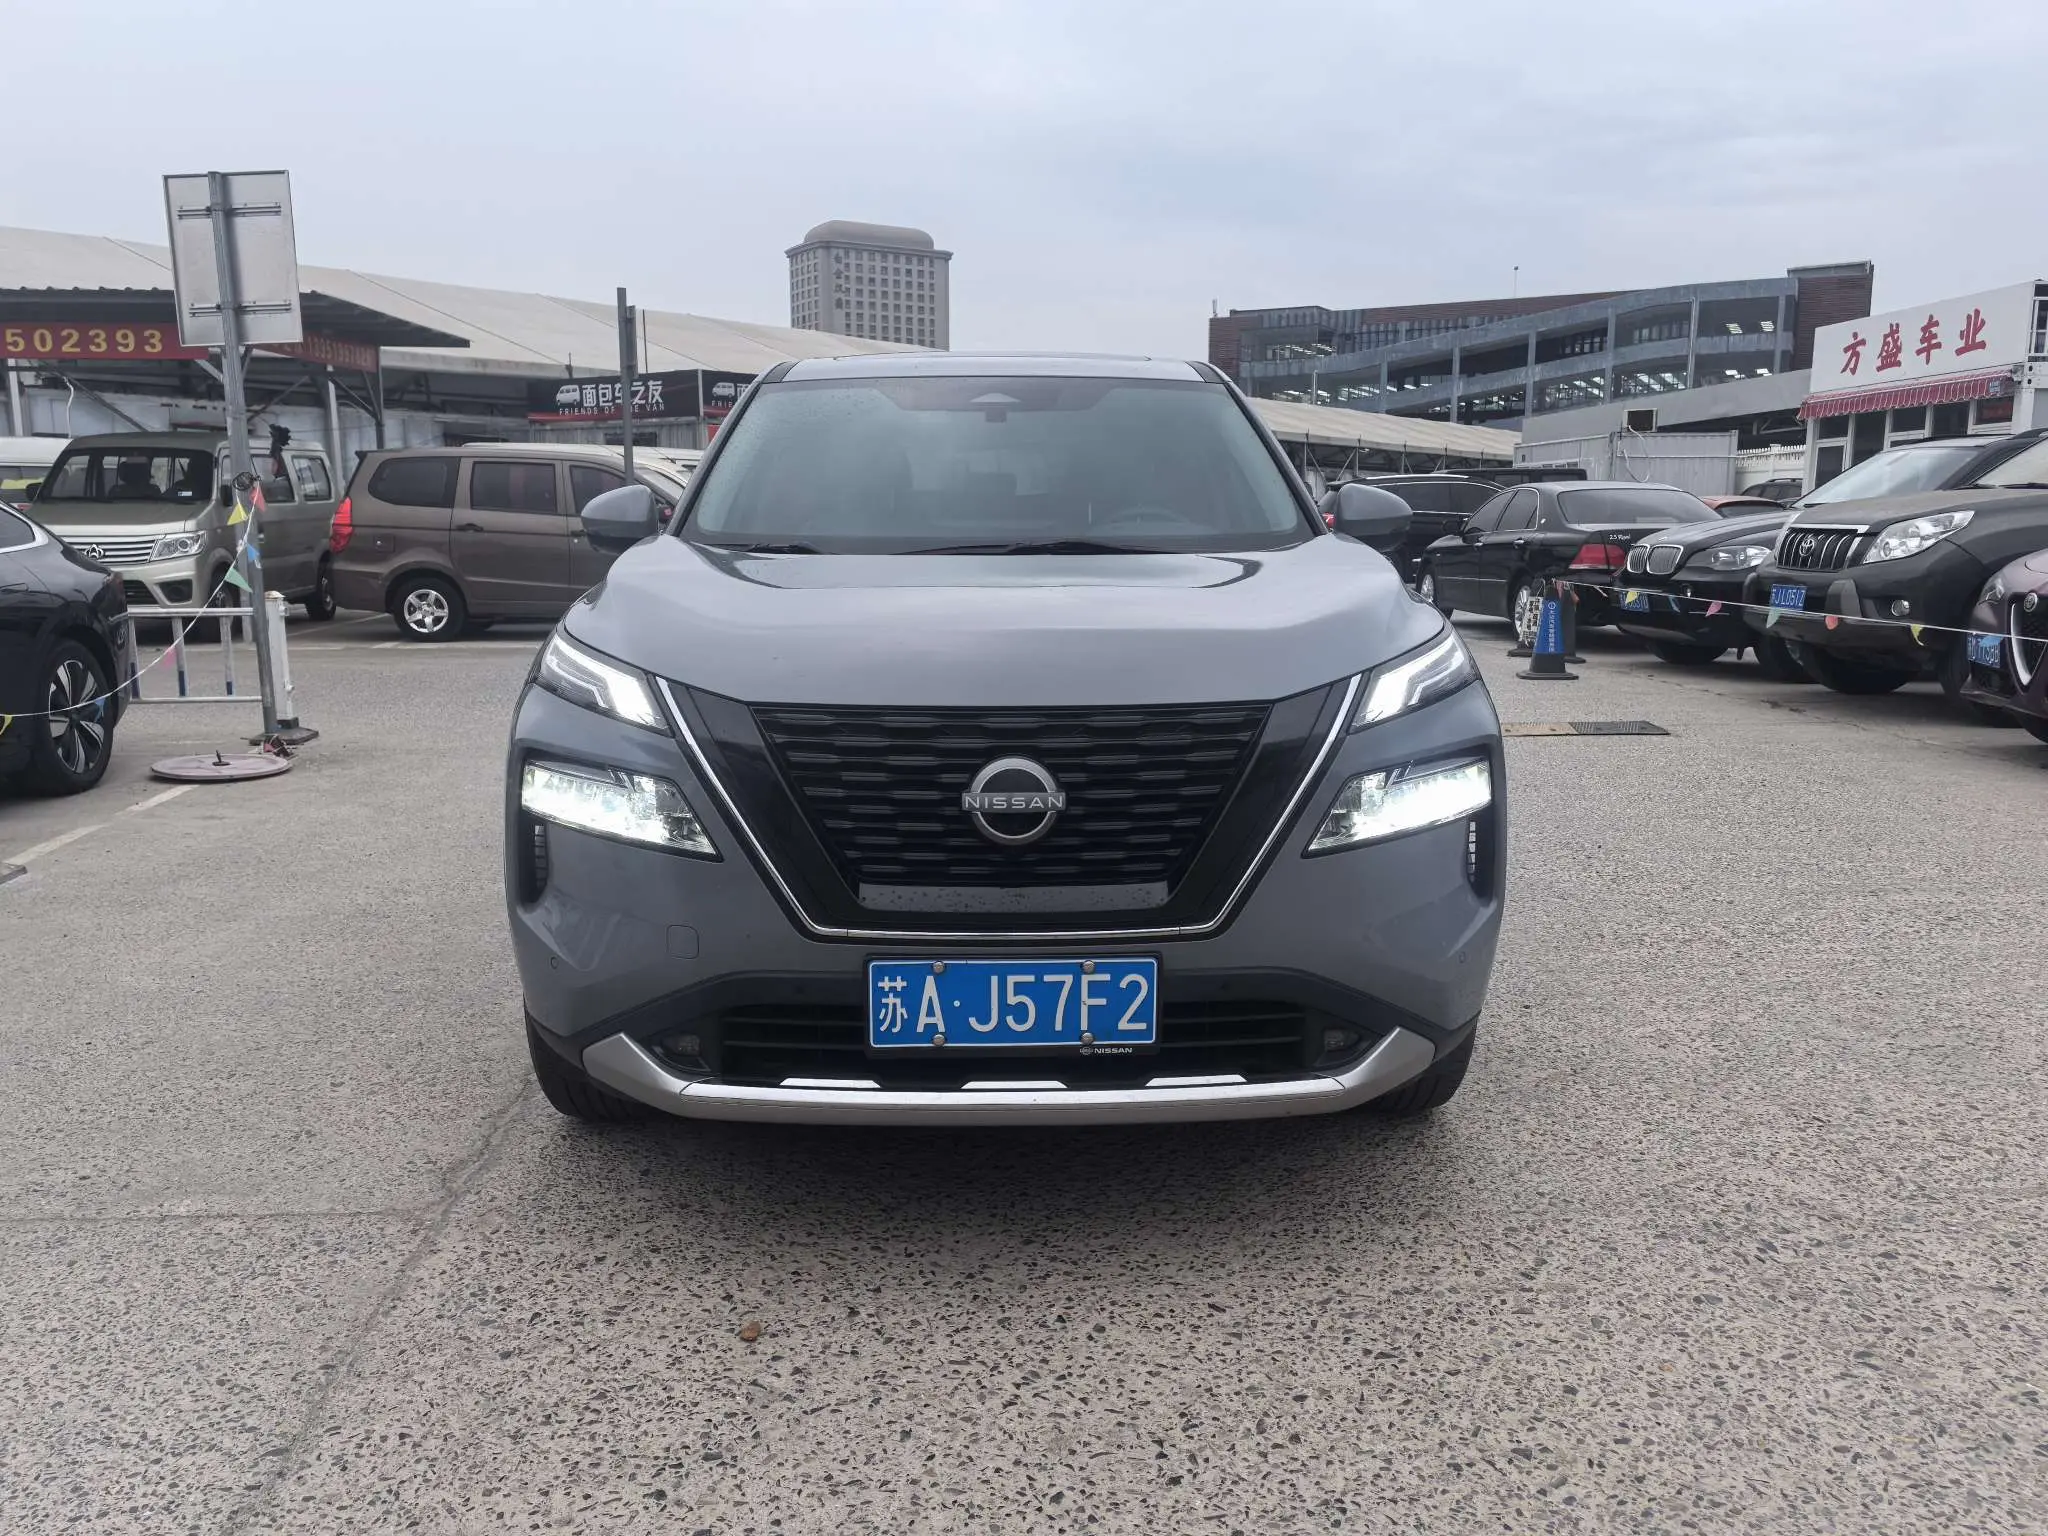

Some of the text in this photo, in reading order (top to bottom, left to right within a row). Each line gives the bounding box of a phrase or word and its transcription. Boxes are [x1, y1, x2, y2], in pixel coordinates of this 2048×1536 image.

[5, 328, 163, 352] 502393
[1840, 308, 1987, 375] 方盛车业
[559, 408, 599, 416] FRIENDS
[646, 403, 665, 412] VAN
[965, 796, 1062, 809] NISSAN
